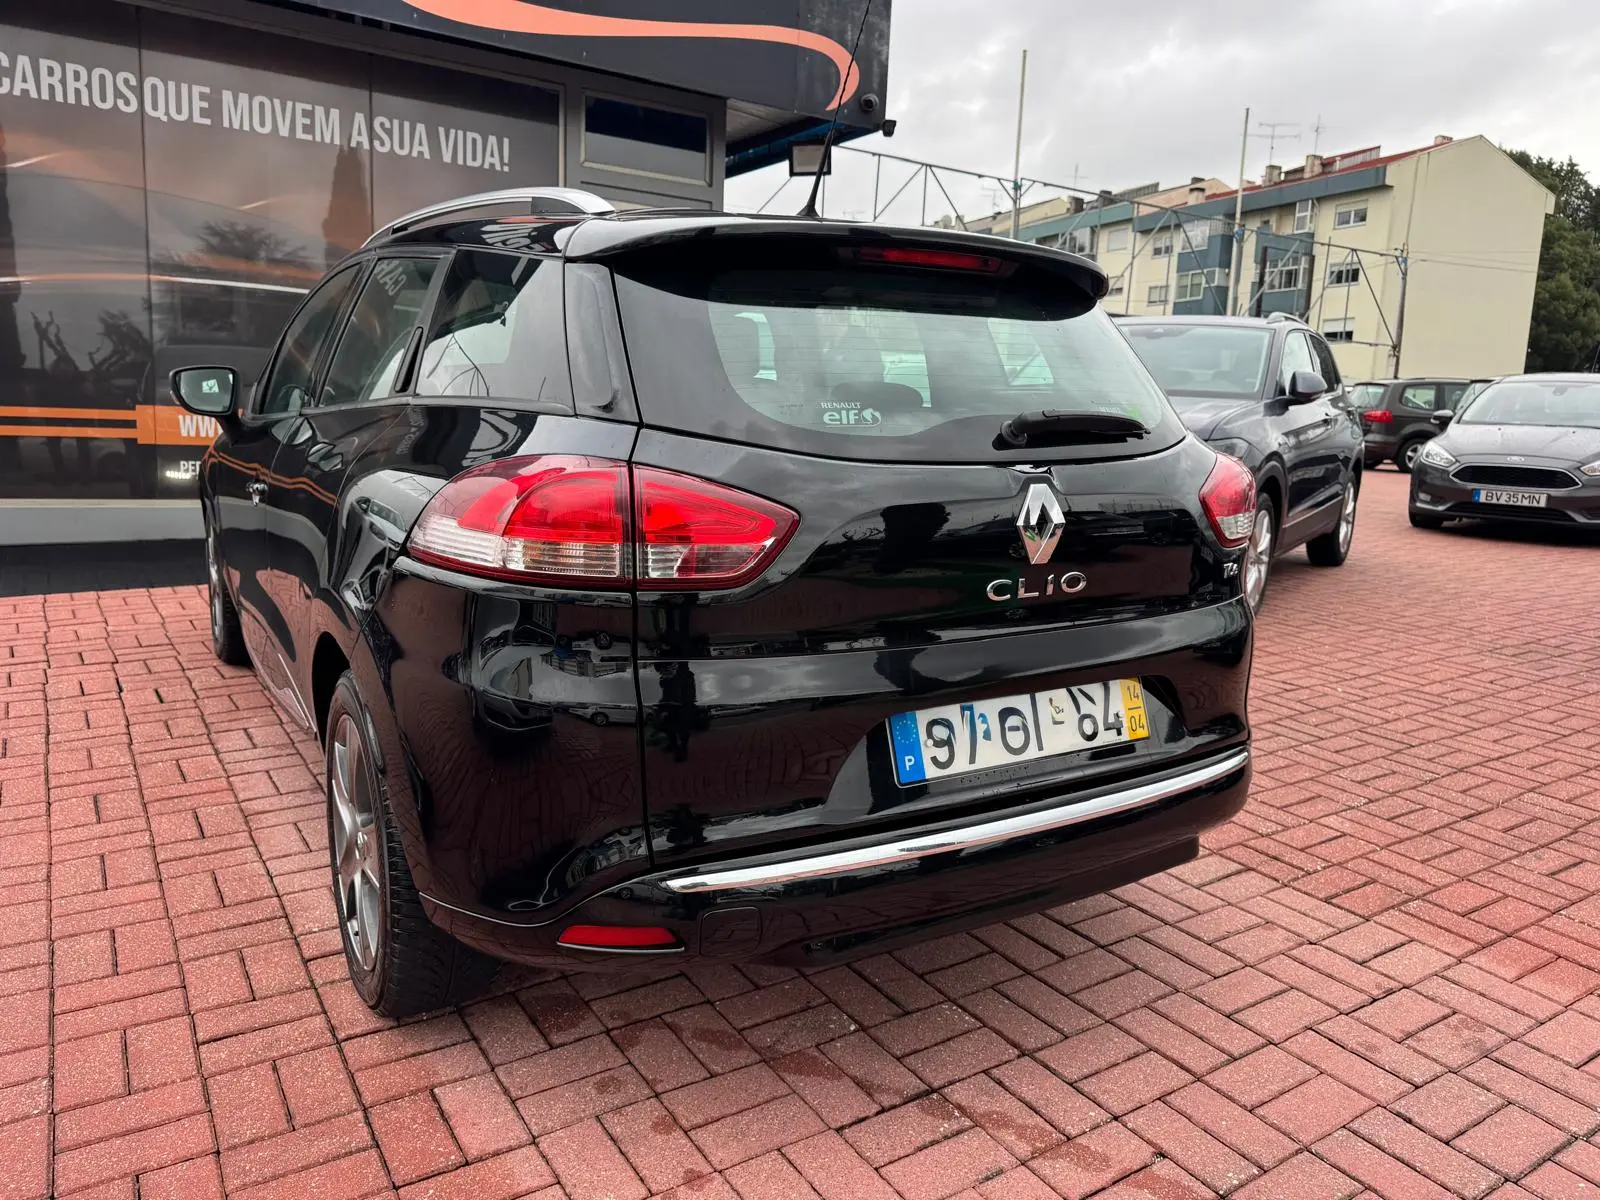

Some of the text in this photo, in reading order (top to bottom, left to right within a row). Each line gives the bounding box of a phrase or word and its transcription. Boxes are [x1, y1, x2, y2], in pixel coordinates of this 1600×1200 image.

[144, 77, 211, 125] QUE
[222, 90, 340, 145] MOVEM
[350, 112, 371, 150] A
[374, 116, 430, 159] SUA
[438, 127, 510, 172] VIDA!
[820, 401, 862, 409] RENAULT
[986, 571, 1087, 602] CLIO
[1129, 714, 1146, 733] 04
[904, 755, 916, 772] P
